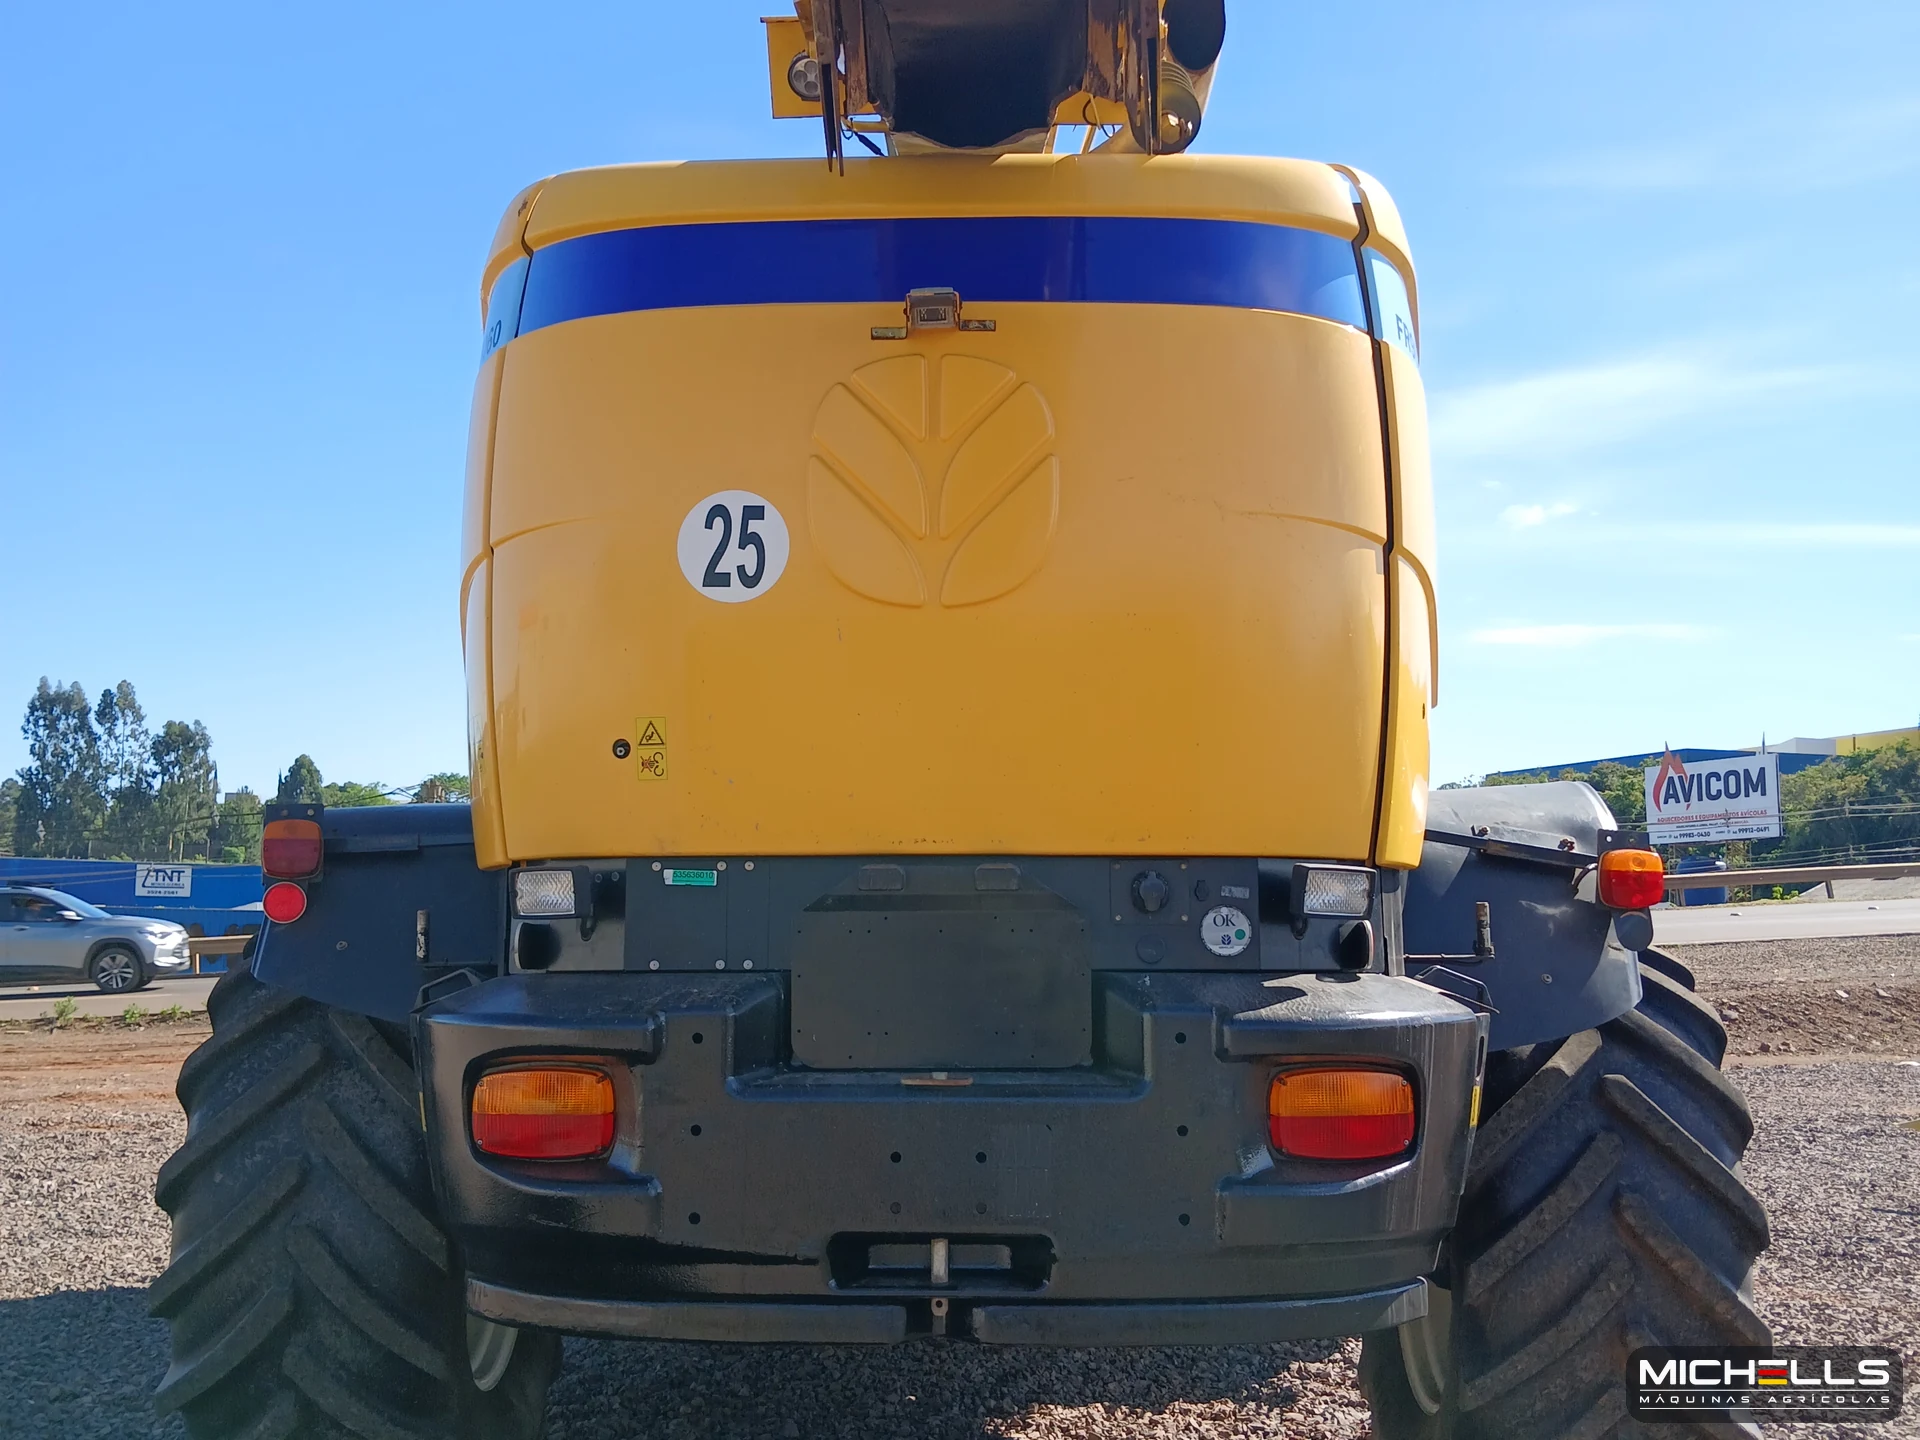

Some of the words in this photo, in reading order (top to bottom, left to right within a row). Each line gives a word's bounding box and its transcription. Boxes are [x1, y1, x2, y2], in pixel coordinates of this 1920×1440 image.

[702, 503, 765, 589] 25
[1663, 766, 1767, 805] AVICOM
[1657, 815, 1695, 823] AQUECEDORES
[1740, 809, 1767, 817] AVÍCOLAS
[153, 868, 185, 882] TNT
[1213, 913, 1236, 927] OK
